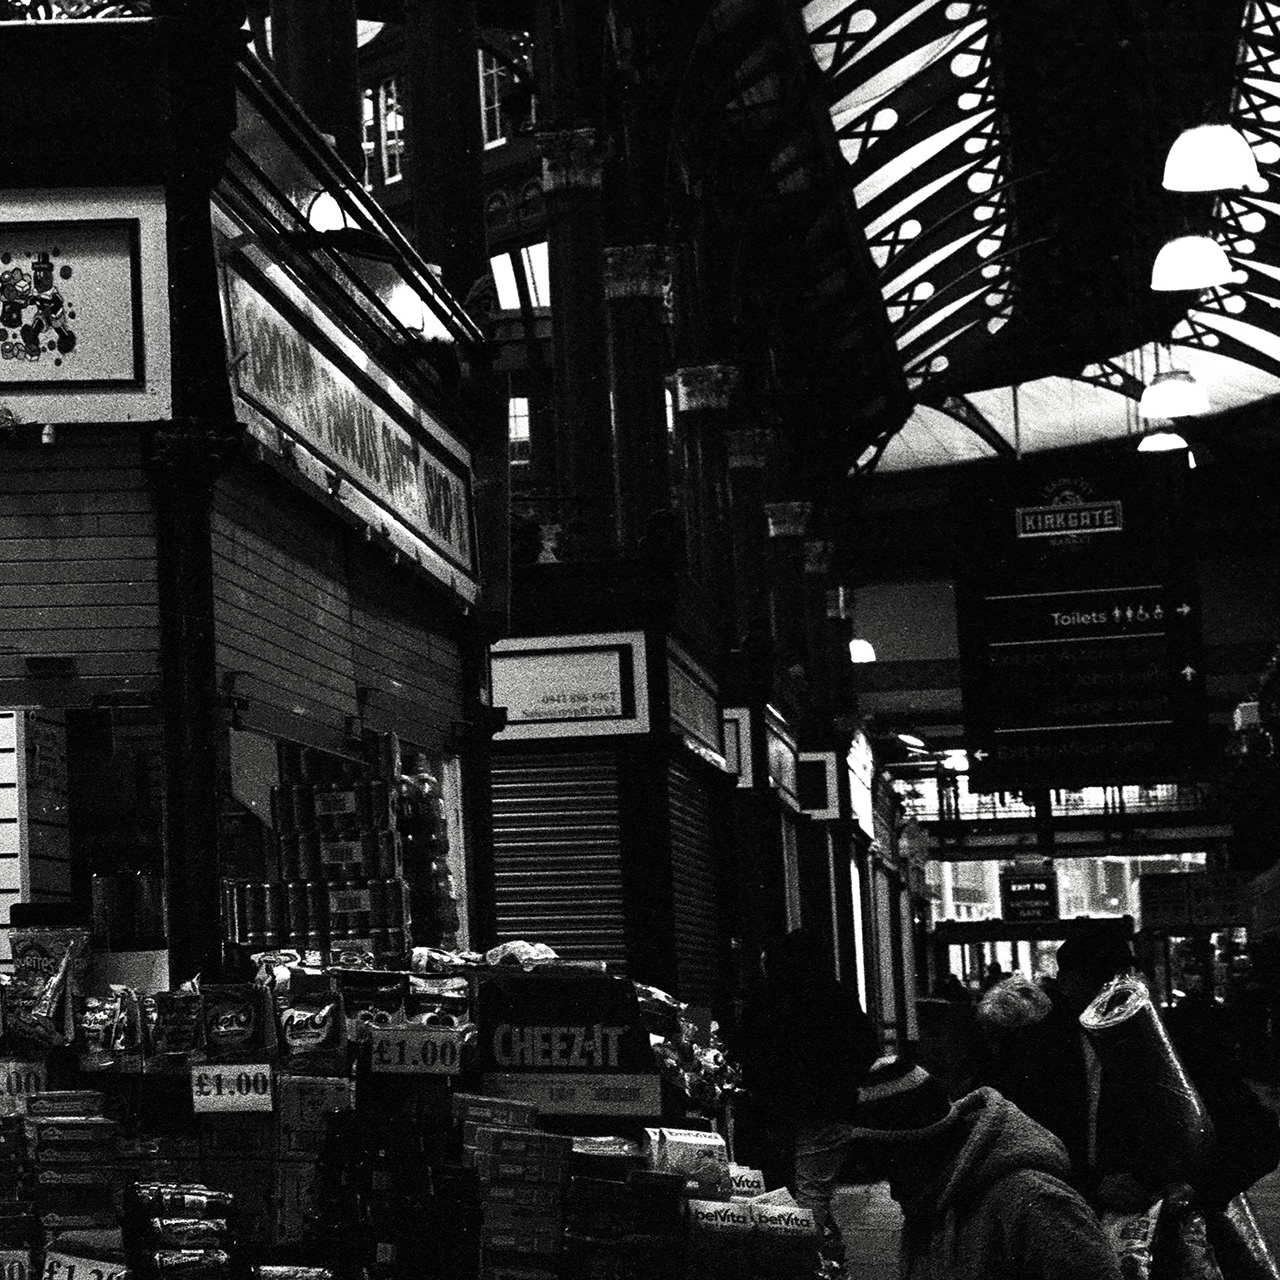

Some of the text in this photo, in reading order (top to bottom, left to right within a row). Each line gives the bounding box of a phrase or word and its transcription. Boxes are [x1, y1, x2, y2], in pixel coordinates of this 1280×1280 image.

[1025, 509, 1115, 531] KIRKGATE
[1051, 609, 1109, 627] Toilets
[373, 1038, 458, 1067] £1.00
[492, 1022, 630, 1067] CHEEZ-IT
[195, 1071, 268, 1097] £1.00
[695, 1207, 747, 1224] belVita
[758, 1211, 811, 1229] belVita
